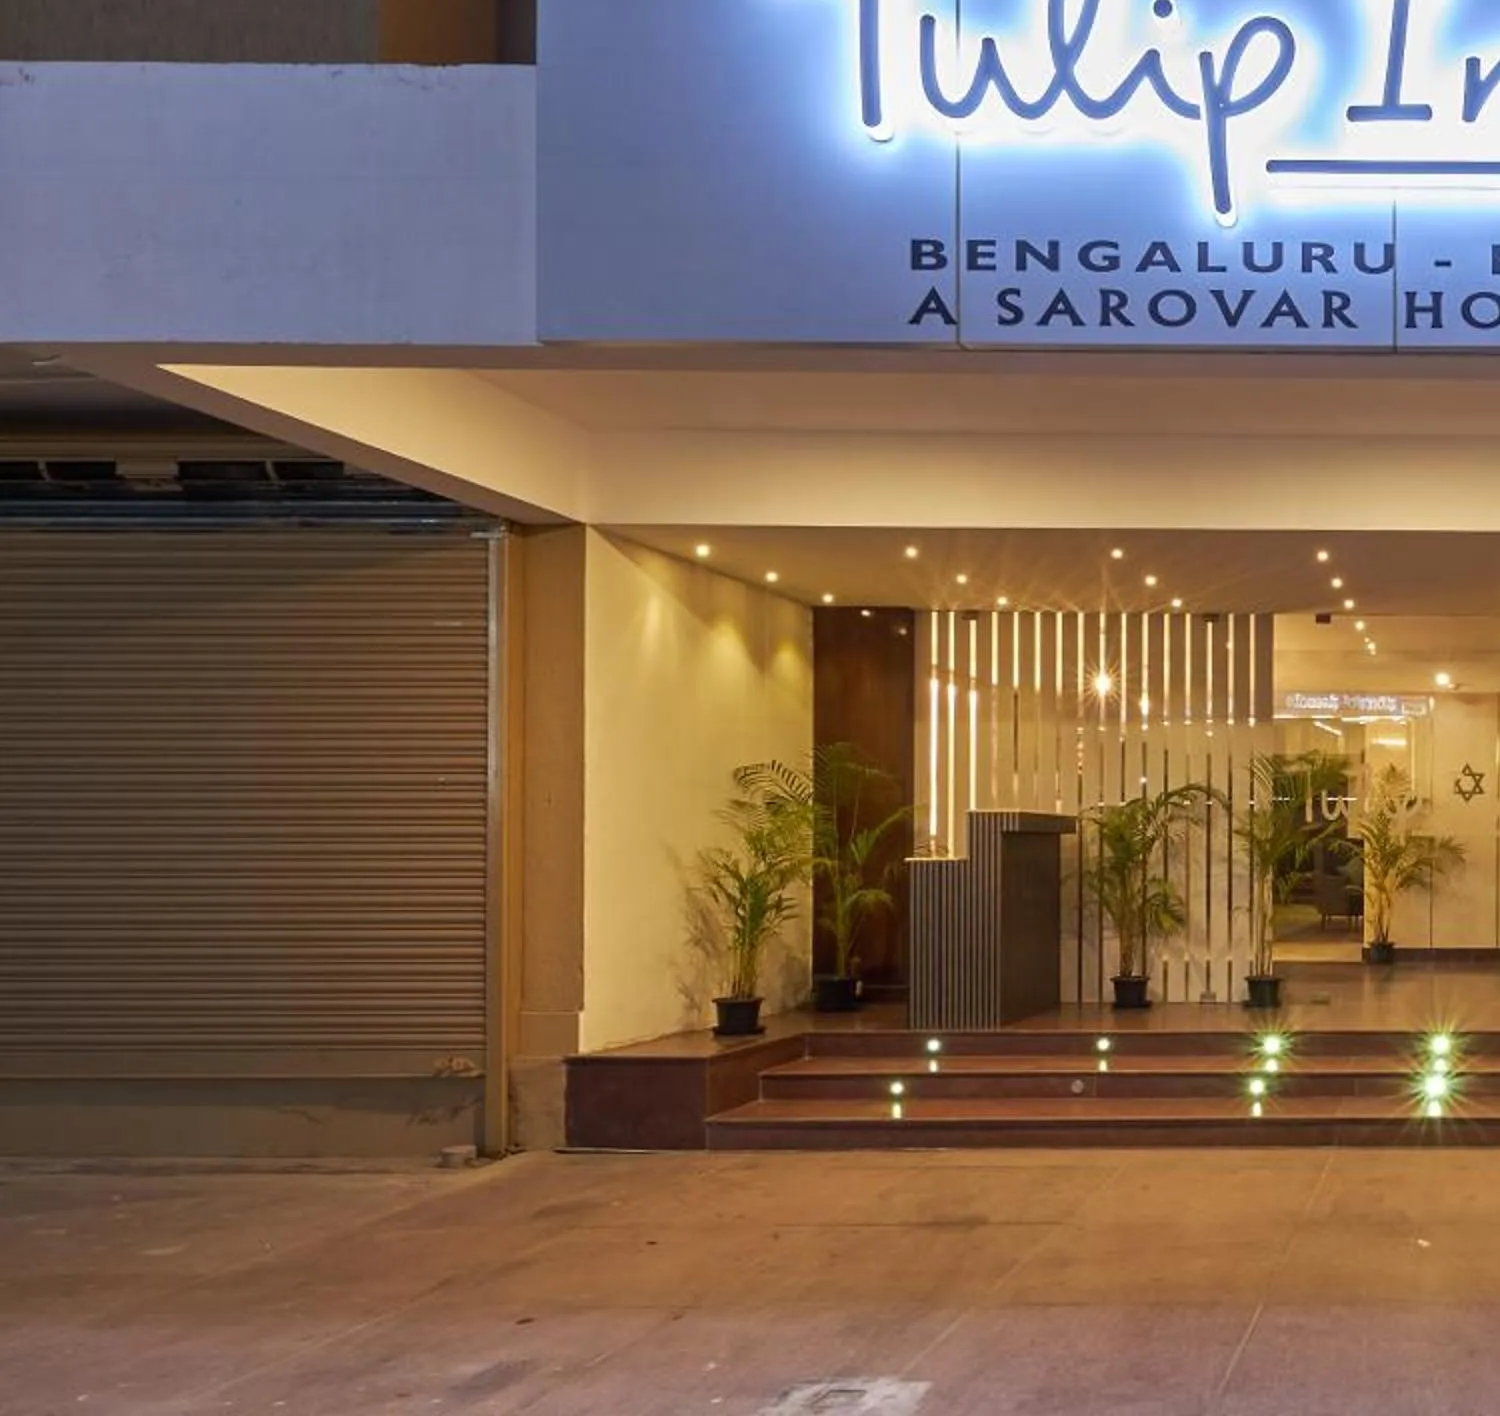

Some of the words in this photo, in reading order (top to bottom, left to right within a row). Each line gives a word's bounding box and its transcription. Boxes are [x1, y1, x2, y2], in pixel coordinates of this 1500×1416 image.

[909, 237, 1397, 275] BENGALURU
[907, 285, 959, 326] A
[995, 285, 1360, 329] SAROVAR
